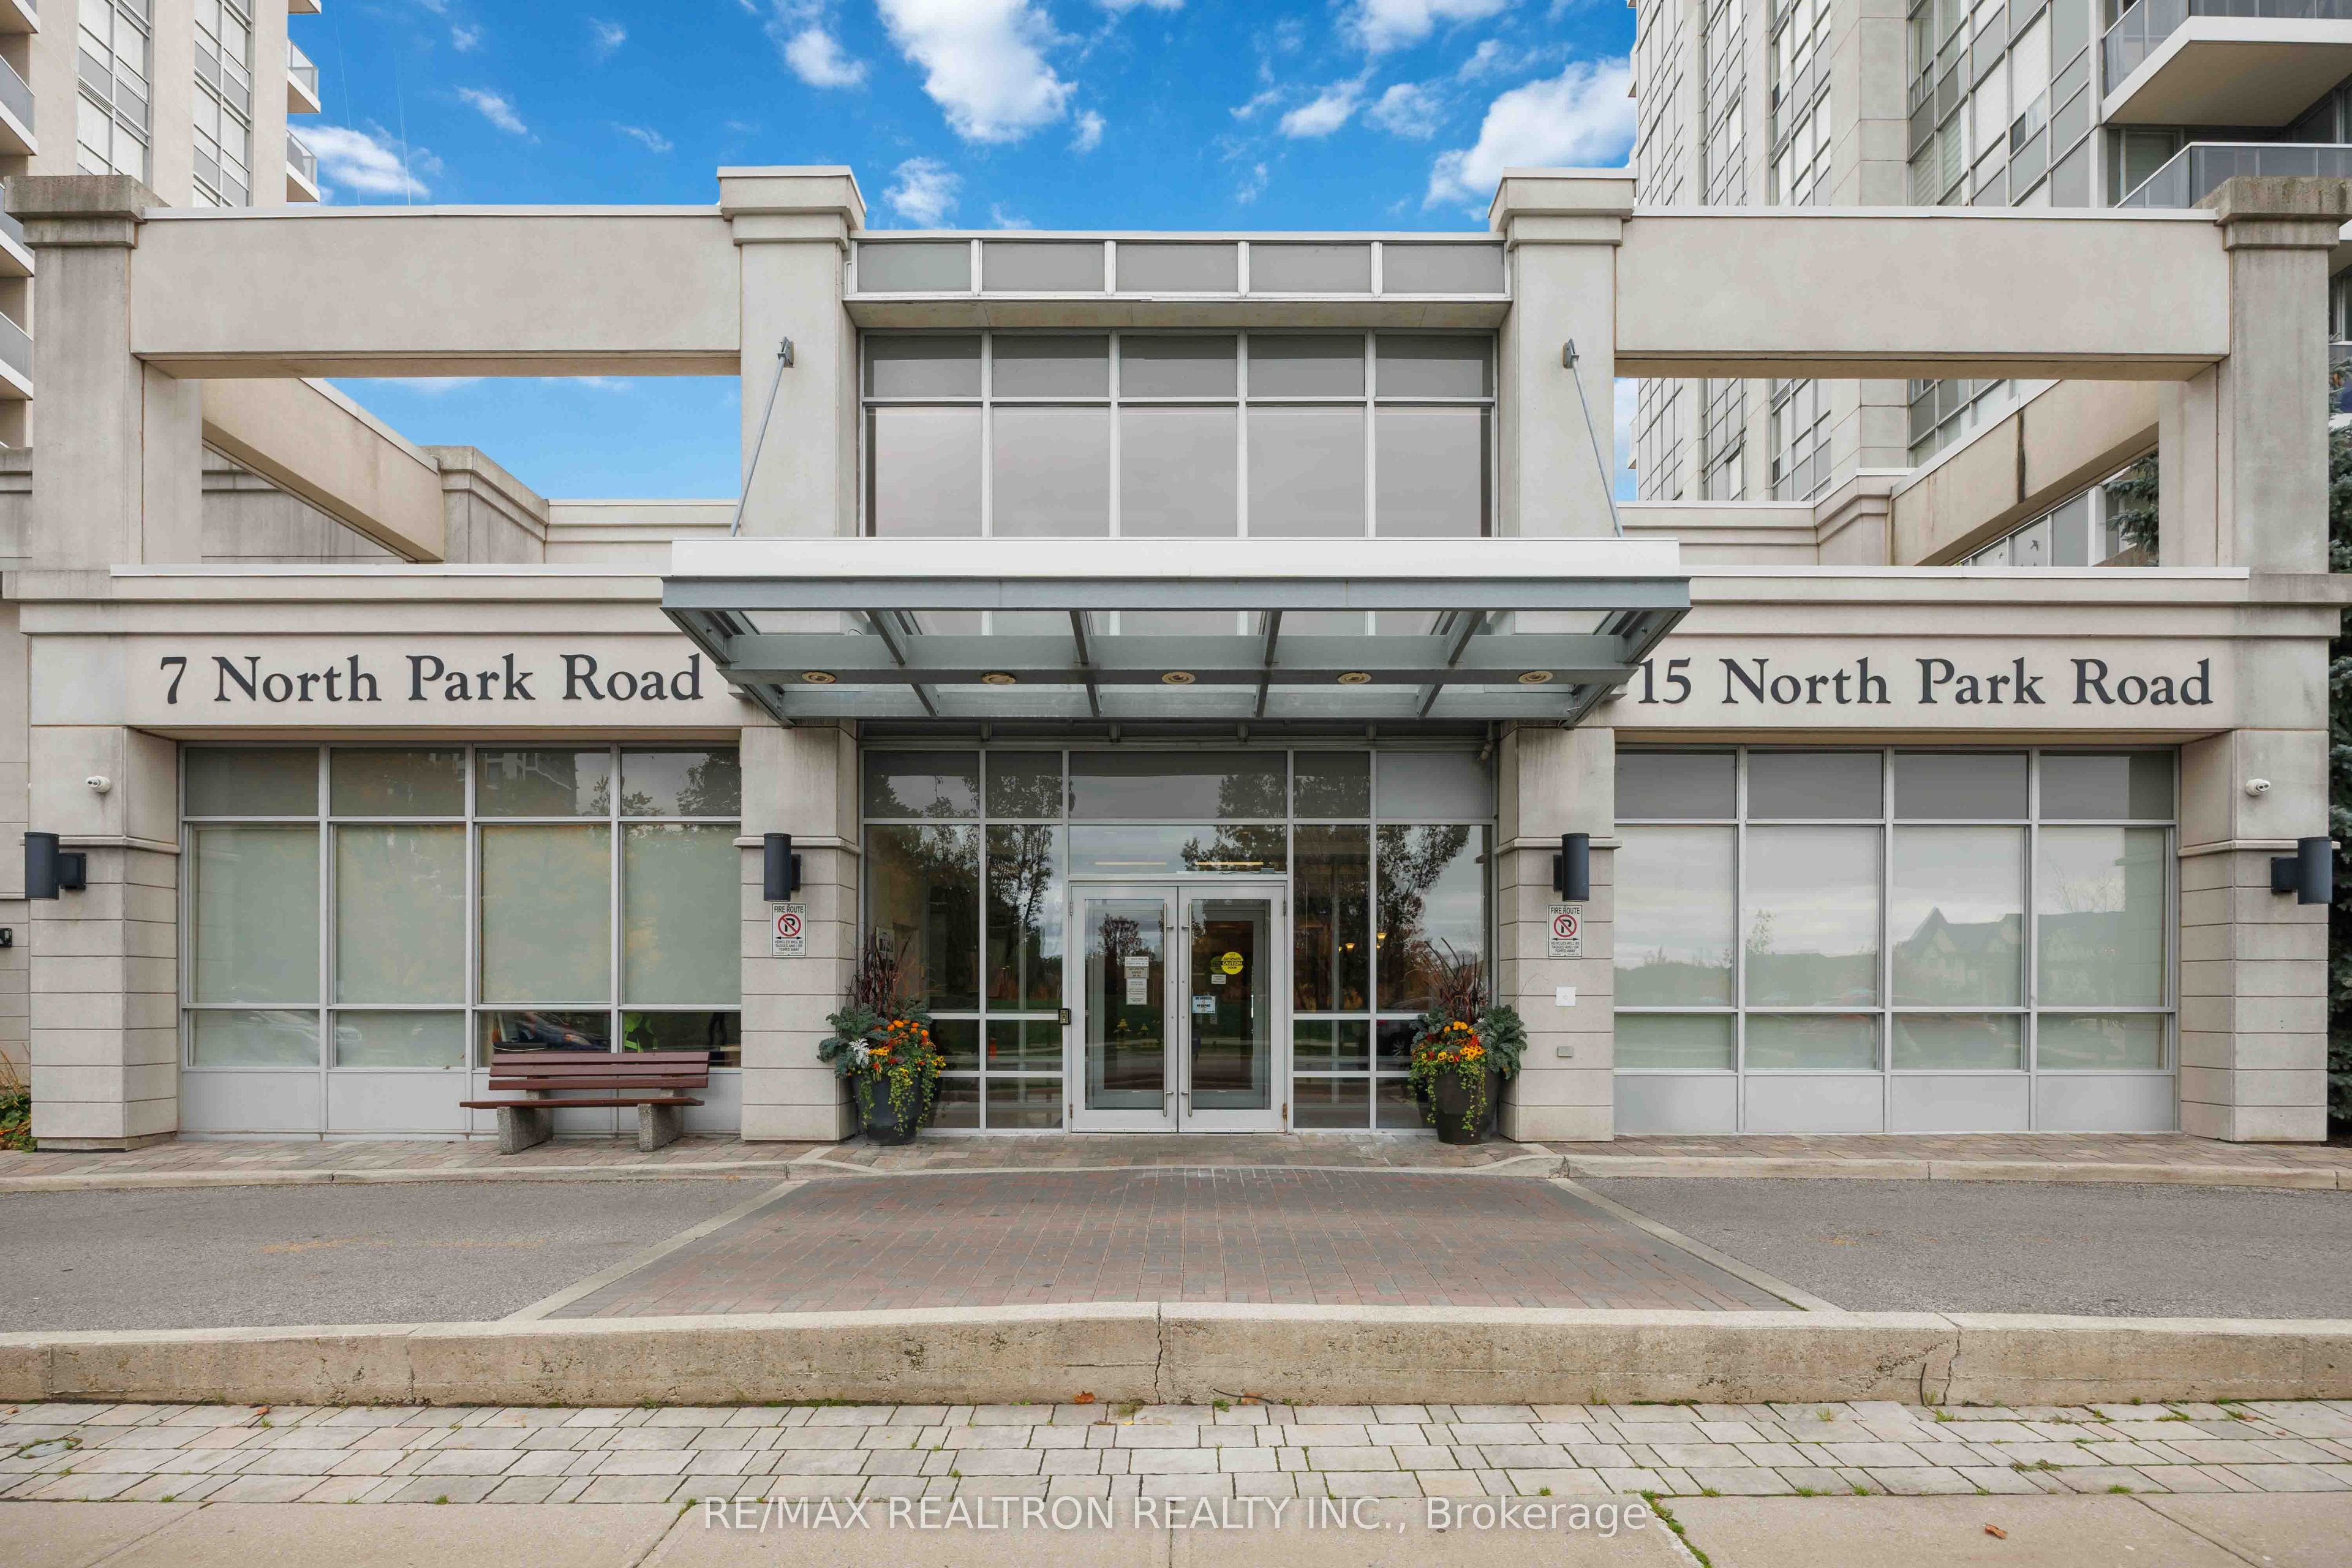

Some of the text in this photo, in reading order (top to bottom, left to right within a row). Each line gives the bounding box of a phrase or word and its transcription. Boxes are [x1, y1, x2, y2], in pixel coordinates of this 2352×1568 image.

[160, 653, 703, 704] 7 North Park Road
[1638, 657, 2213, 705] 15 North Park Road
